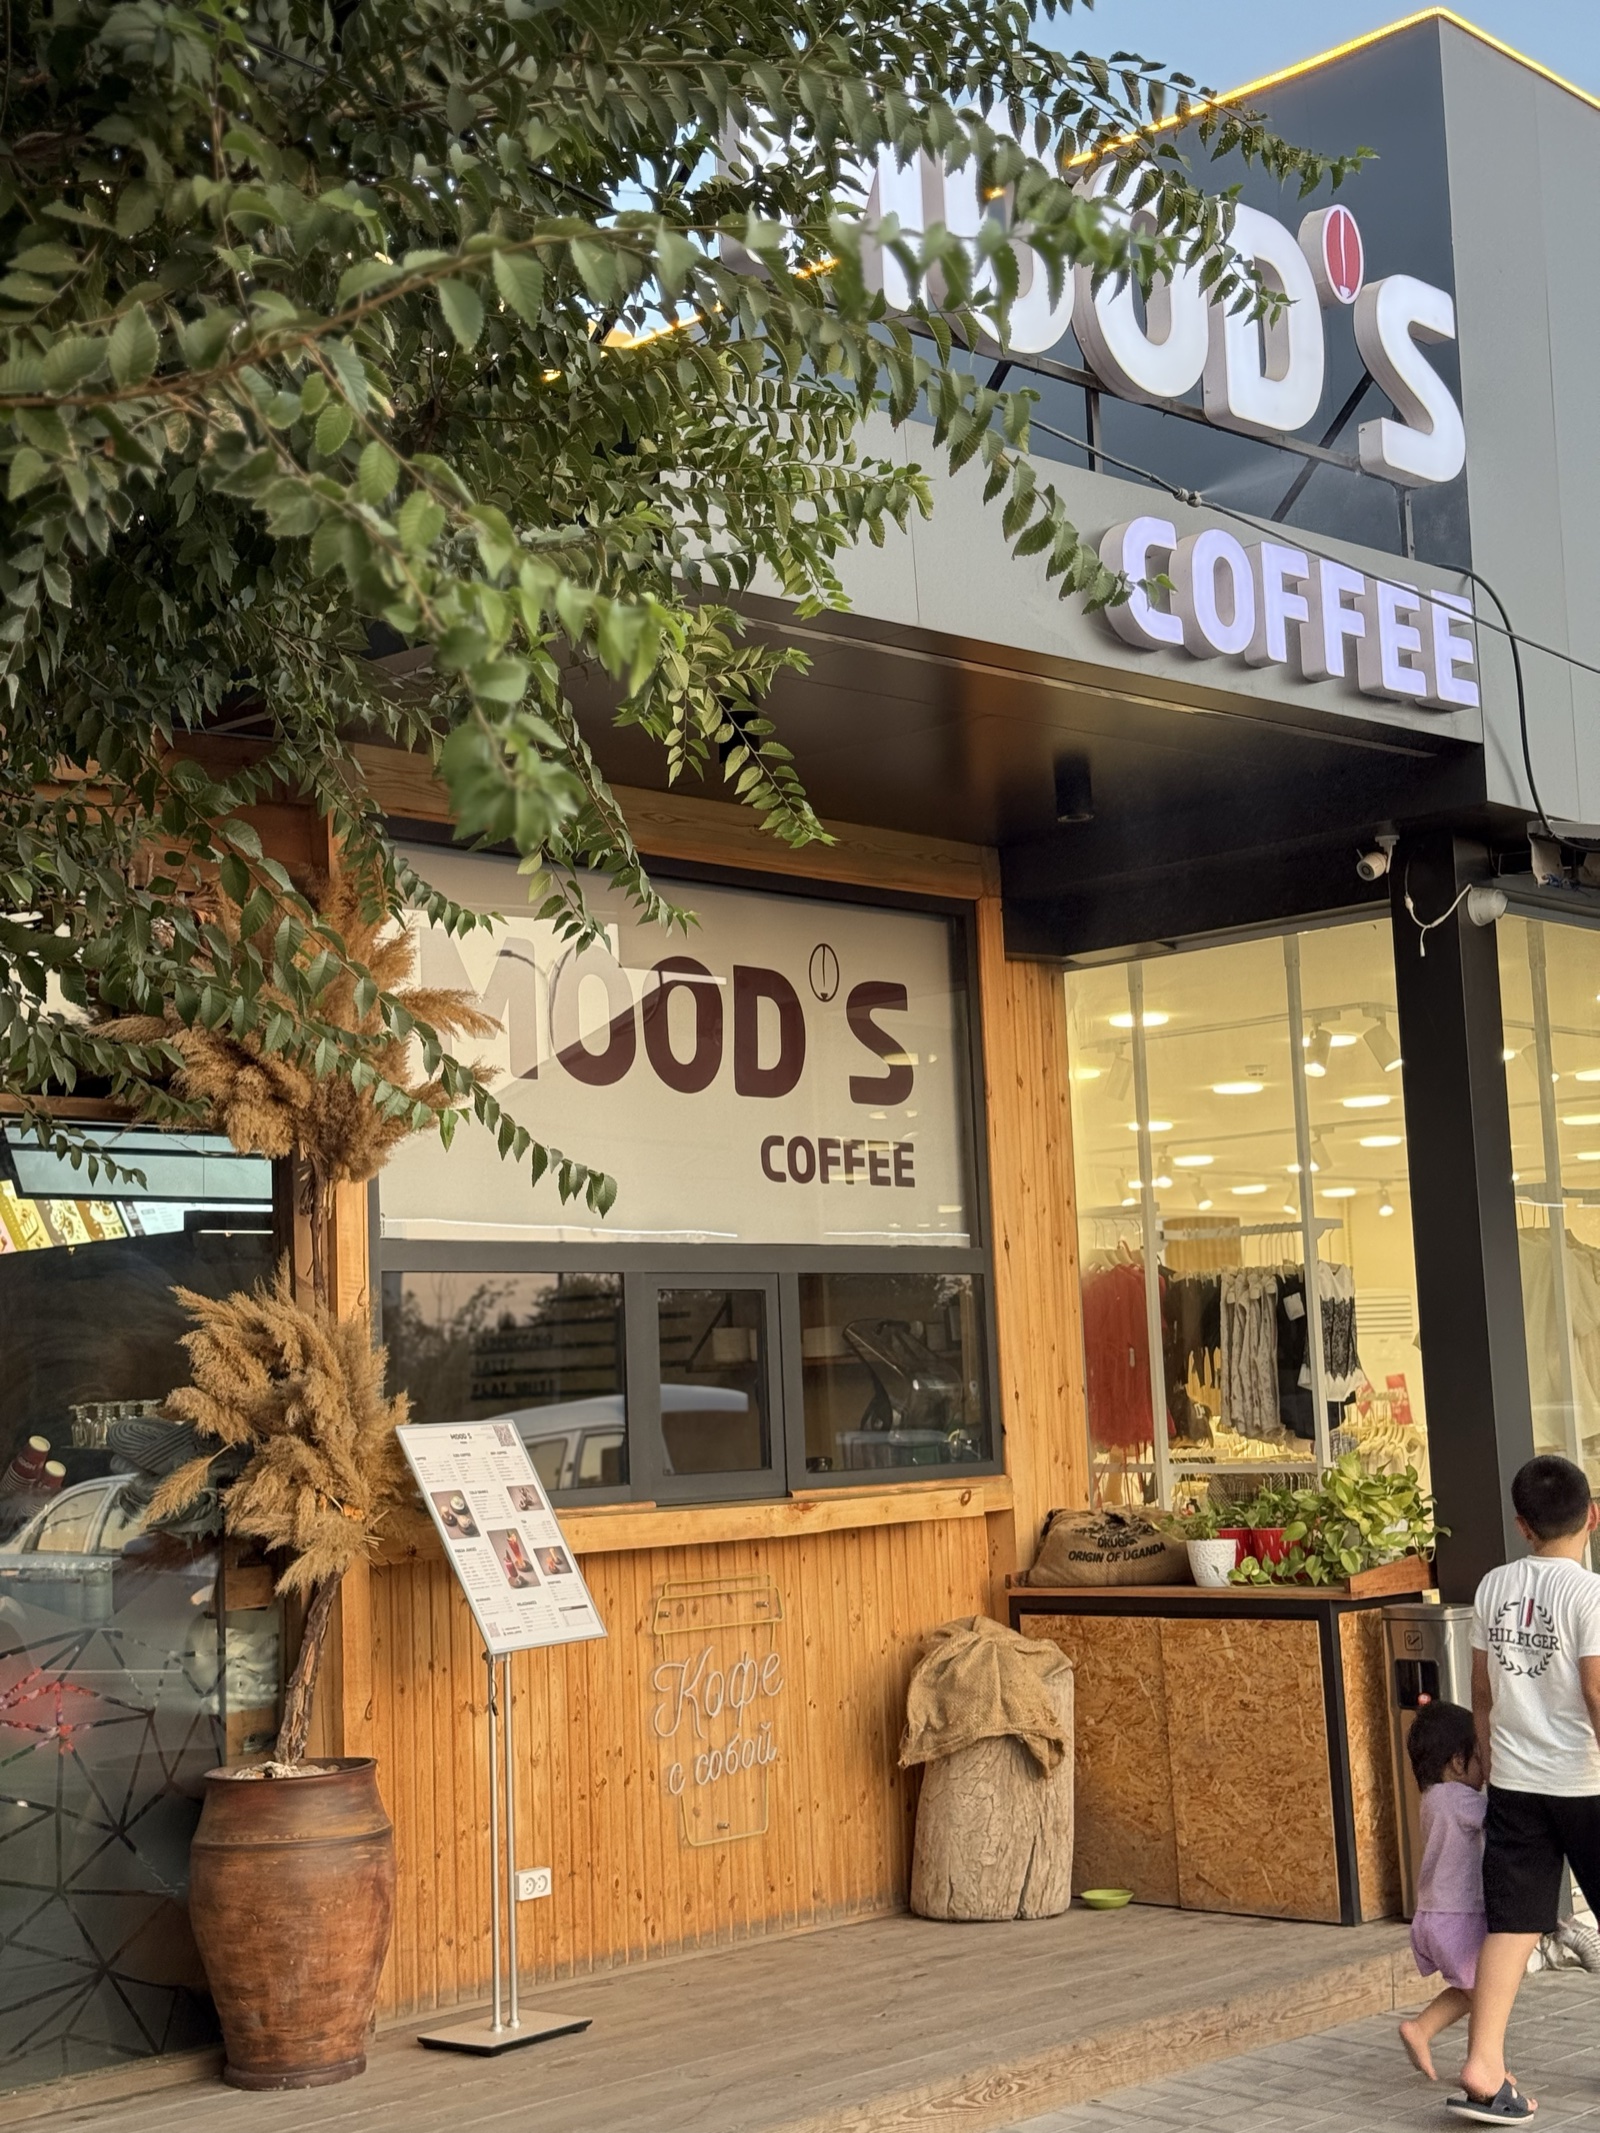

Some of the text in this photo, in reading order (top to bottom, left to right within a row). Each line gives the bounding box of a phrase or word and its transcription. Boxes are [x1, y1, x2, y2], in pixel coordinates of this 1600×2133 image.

[1112, 516, 1480, 710] COFFEE
[760, 1134, 916, 1188] COFFEE
[1068, 1541, 1167, 1563] ORIGIN OF UGANDA
[1488, 1628, 1560, 1651] HILFIGER
[653, 1646, 784, 1739] Кофе
[694, 1721, 778, 1786] собой
